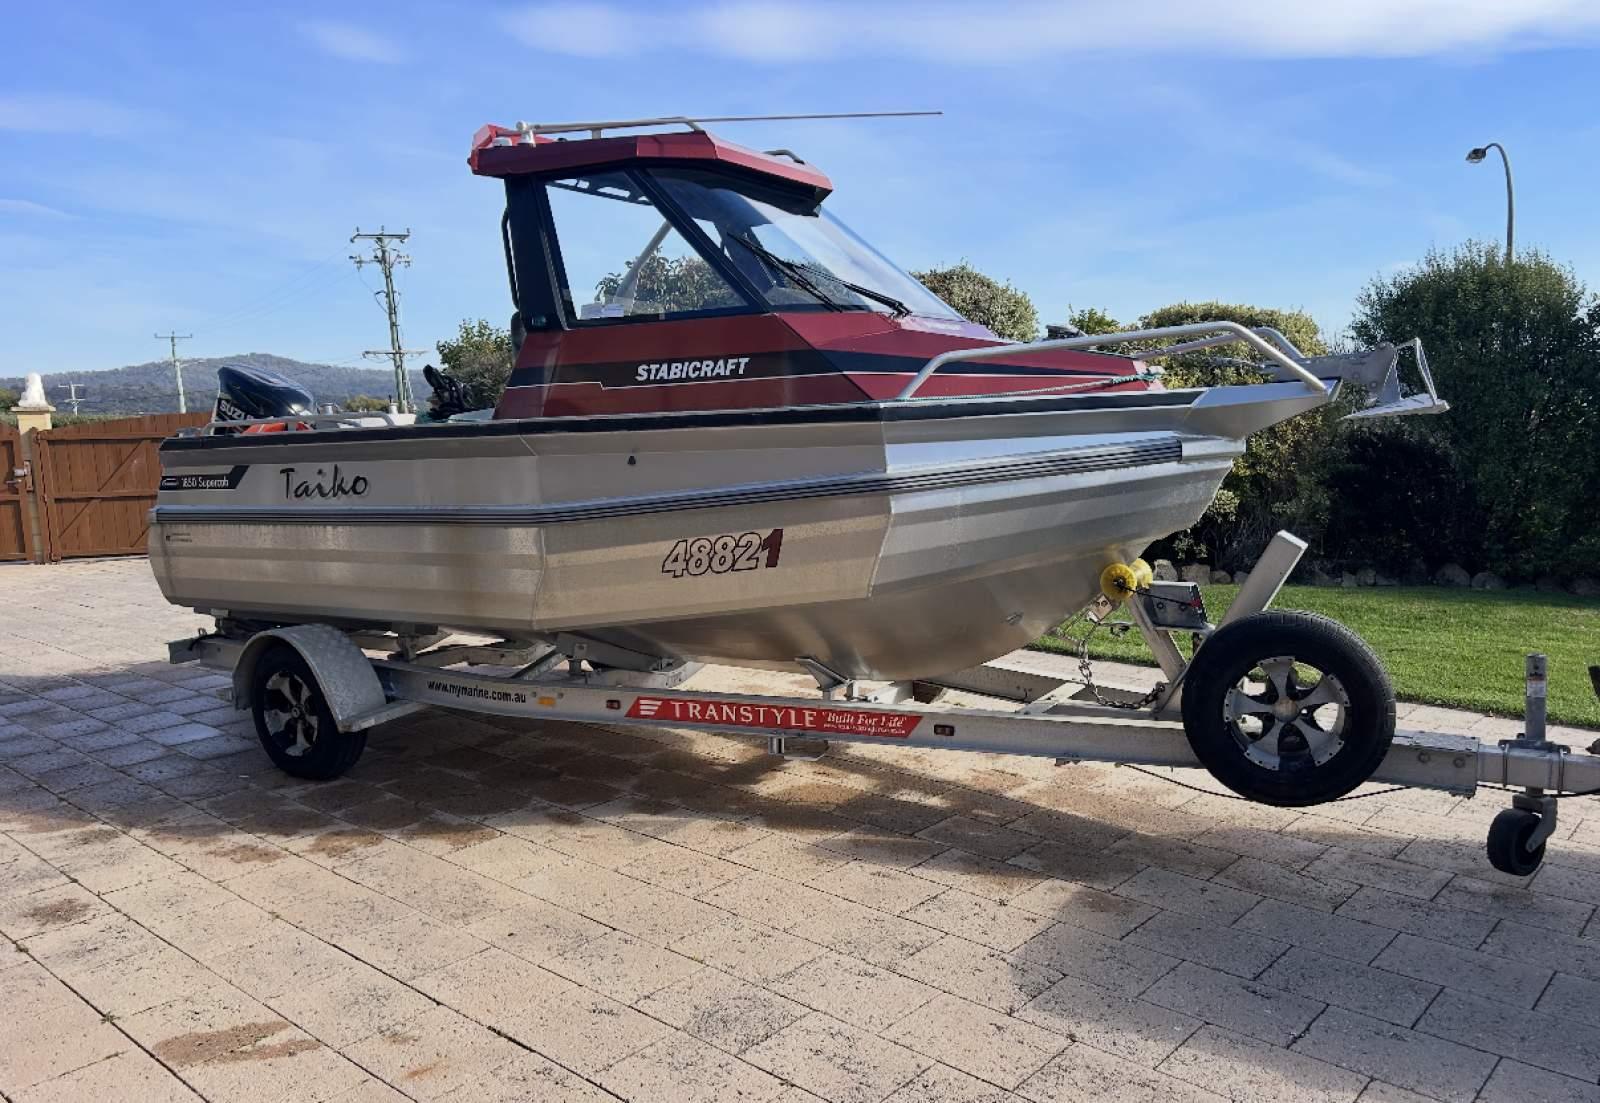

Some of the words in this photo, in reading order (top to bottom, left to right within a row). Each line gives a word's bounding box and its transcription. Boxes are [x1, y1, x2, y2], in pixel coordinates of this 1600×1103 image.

[635, 358, 750, 381] STABICRAFT
[280, 464, 368, 499] Taiko
[662, 529, 783, 578] 48821
[427, 680, 526, 703] www.mymarine.com.au
[671, 701, 817, 728] TRANSTYLE
[857, 714, 878, 725] For
